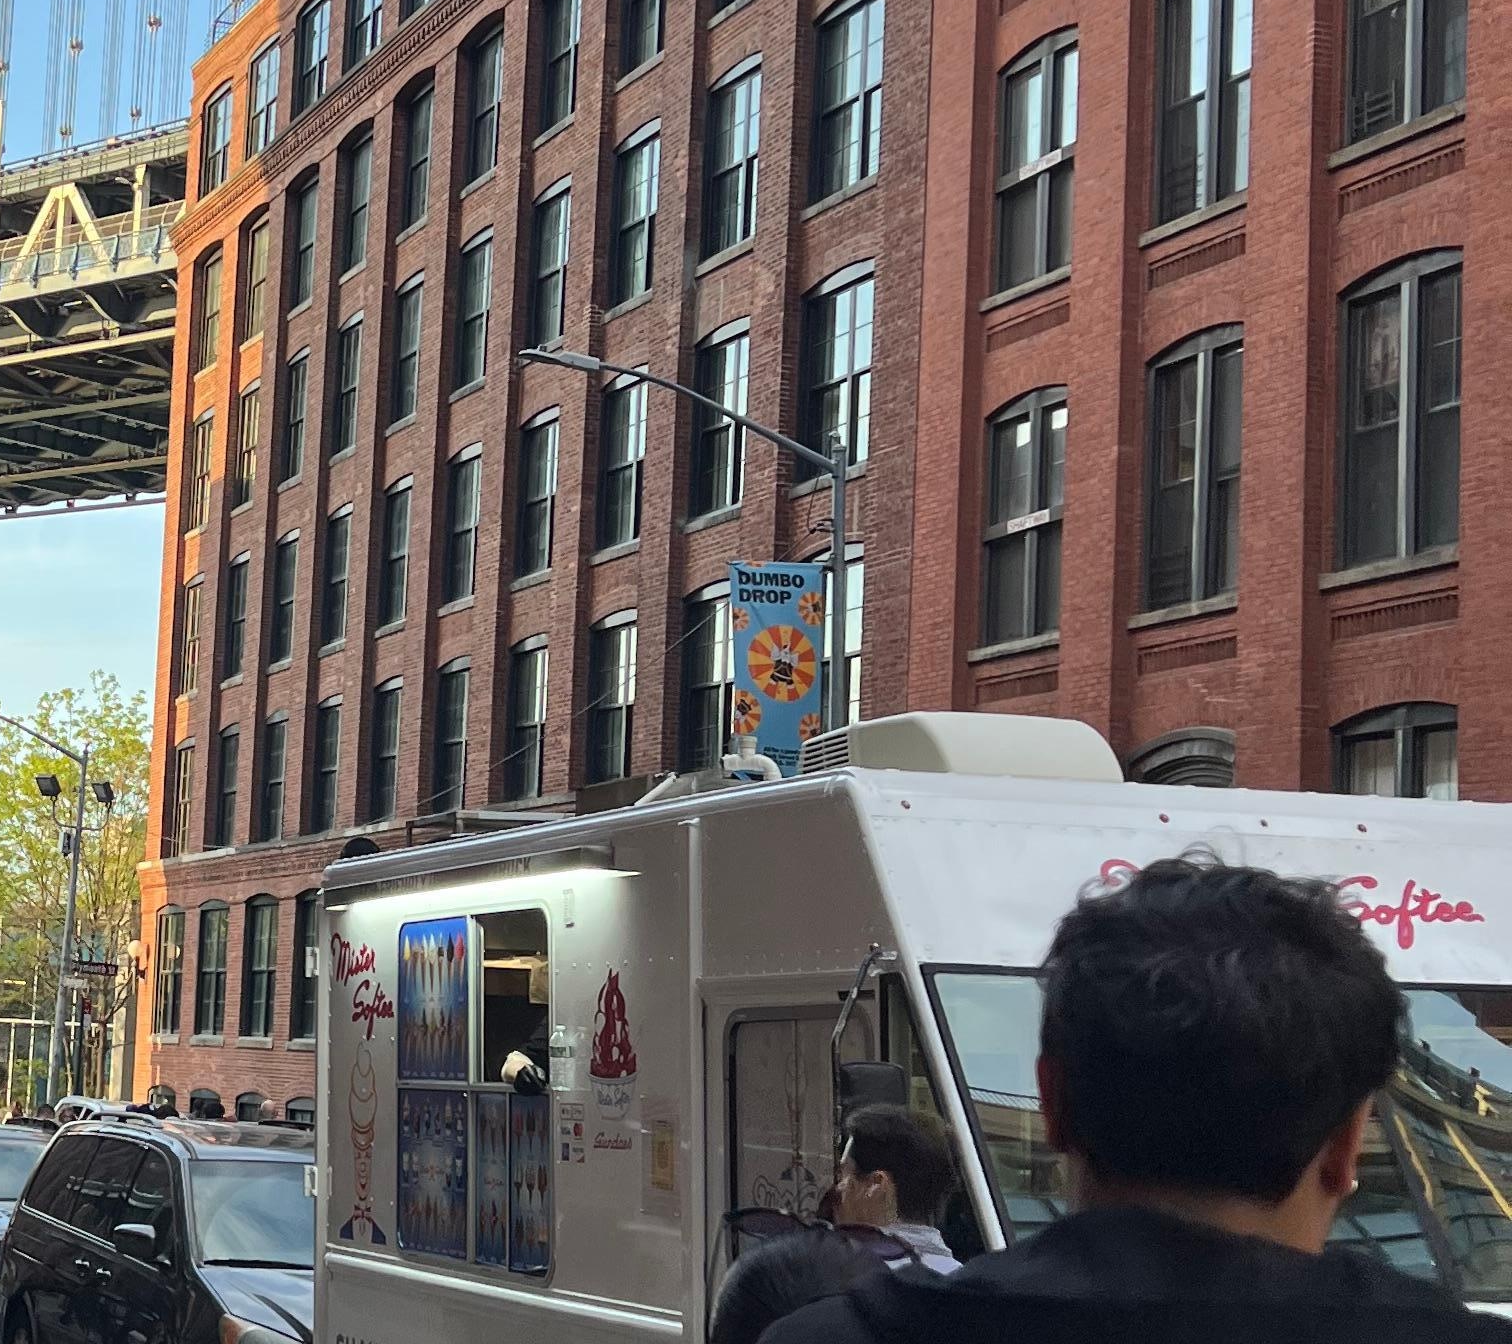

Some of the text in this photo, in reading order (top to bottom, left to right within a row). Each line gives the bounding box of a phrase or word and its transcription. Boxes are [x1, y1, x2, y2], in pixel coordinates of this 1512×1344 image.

[738, 570, 805, 589] DUMBO
[738, 588, 792, 605] DROP
[330, 932, 376, 987] Mister
[351, 978, 395, 1042] Softee
